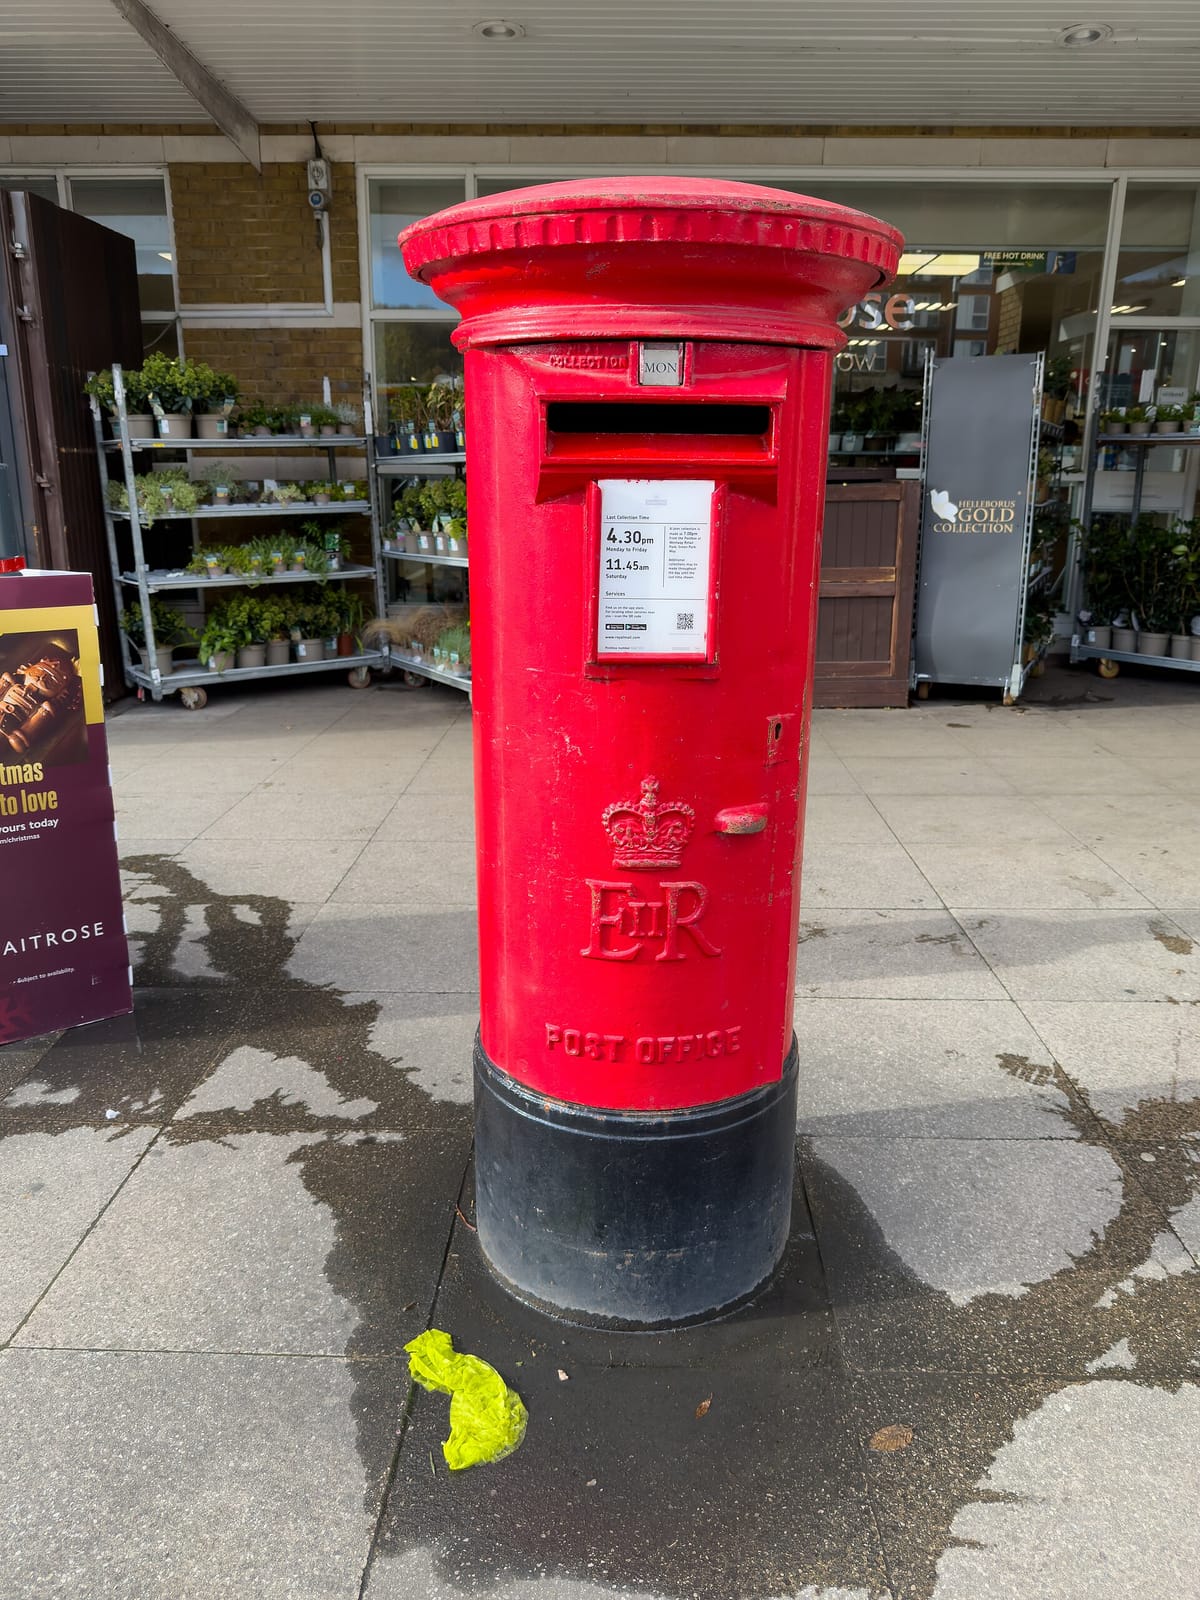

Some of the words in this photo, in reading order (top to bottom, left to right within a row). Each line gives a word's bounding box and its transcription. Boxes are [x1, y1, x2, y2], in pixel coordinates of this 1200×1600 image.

[984, 252, 1001, 260] FREE
[1003, 252, 1019, 260] HOT
[1021, 252, 1045, 260] DRINK
[549, 355, 629, 370] COLLECTION
[644, 361, 677, 374] MON
[958, 500, 1016, 508] HELLEBORUS
[958, 508, 1015, 523] GOLD
[933, 523, 1013, 533] COLLECTION
[606, 527, 654, 546] 4.30pm
[606, 558, 650, 571] 11.45am
[0, 793, 18, 816] to
[21, 789, 58, 814] love
[29, 818, 59, 829] today
[3, 922, 104, 956] AITROSE
[545, 1022, 625, 1063] POST
[636, 1025, 742, 1065] OFFICE
